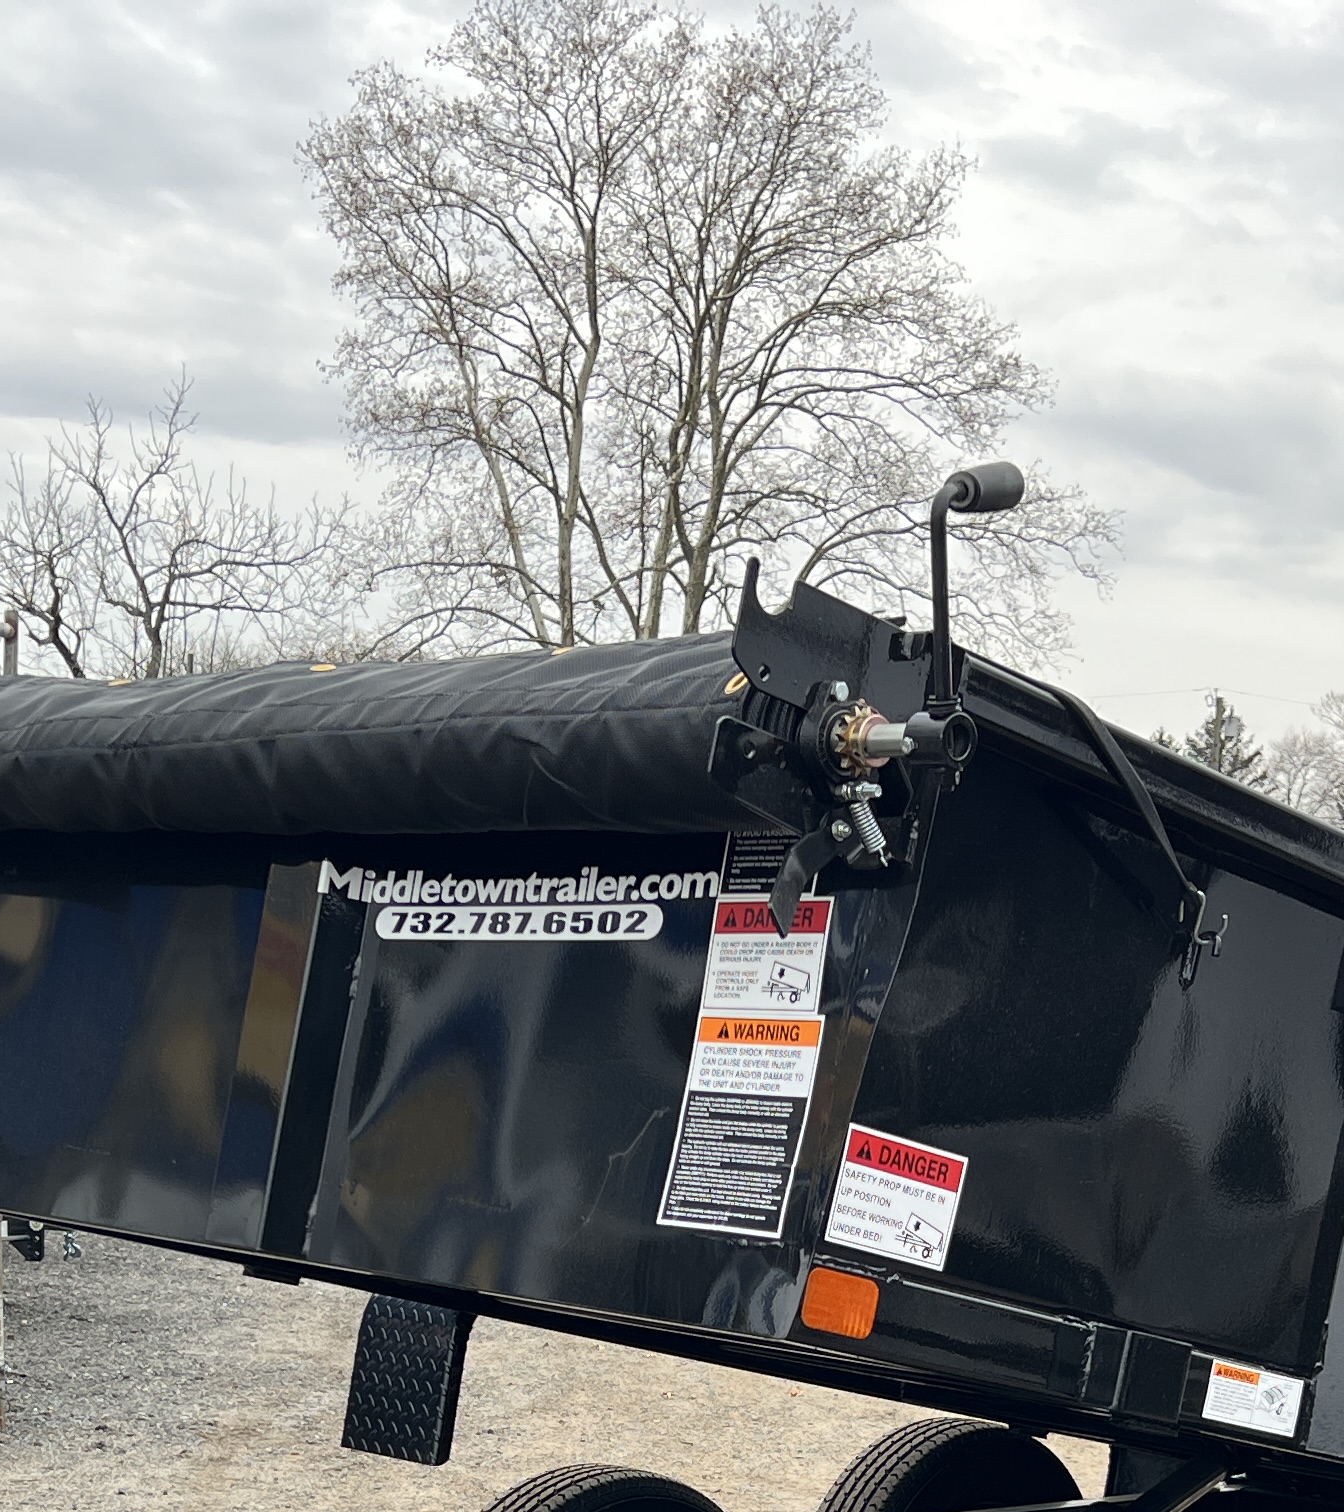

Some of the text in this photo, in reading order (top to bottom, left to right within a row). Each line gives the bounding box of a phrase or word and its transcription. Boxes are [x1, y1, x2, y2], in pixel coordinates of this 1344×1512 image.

[317, 859, 719, 904] Middletowntrailer.com
[390, 910, 649, 935] 732.787.6502
[743, 908, 814, 929] DANER
[733, 1023, 800, 1042] WARNING
[878, 1144, 949, 1183] DANGER
[840, 1186, 892, 1208] UP POSITION
[845, 1168, 946, 1205] SAFETY PROP MUST BE IN
[837, 1204, 903, 1229] BEFORE WORKING
[832, 1222, 861, 1236] UNDER
[1223, 1368, 1255, 1383] WARNING
